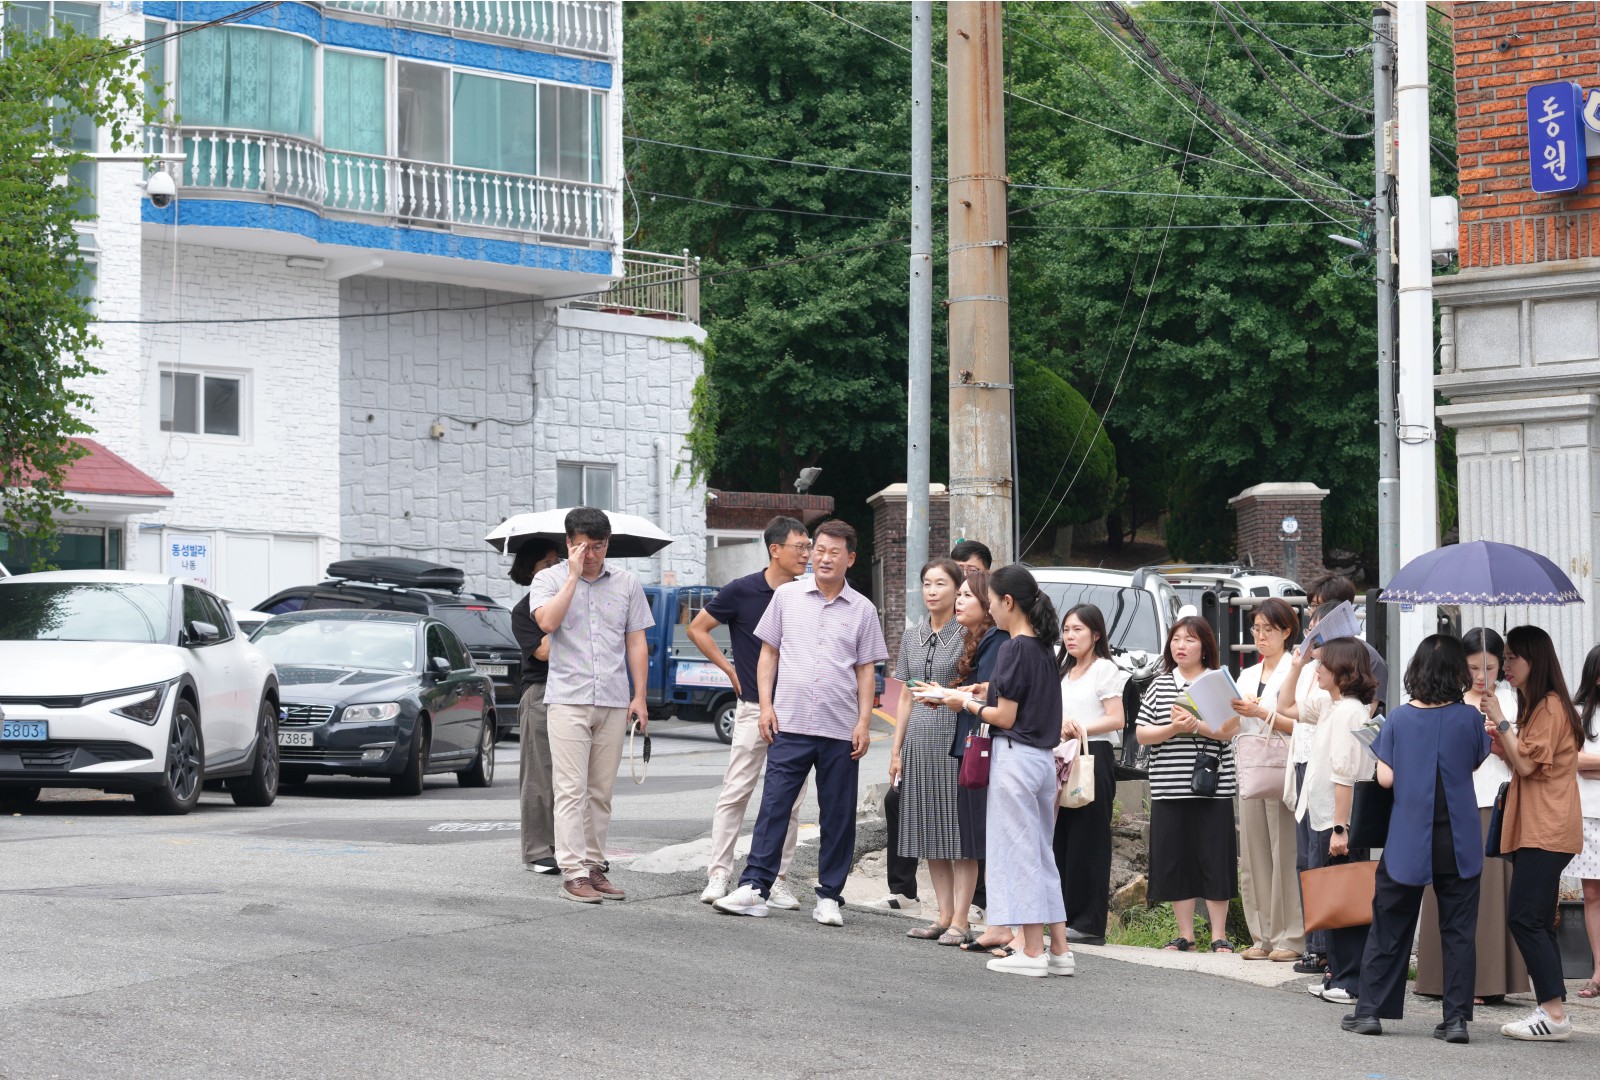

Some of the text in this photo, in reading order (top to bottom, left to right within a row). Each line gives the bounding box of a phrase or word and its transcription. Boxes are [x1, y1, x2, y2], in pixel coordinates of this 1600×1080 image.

[1537, 96, 1567, 182] 동원
[172, 544, 207, 557] 동성빌라
[181, 561, 196, 570] 나동
[3, 724, 39, 738] 5803
[279, 733, 307, 744] 7385
